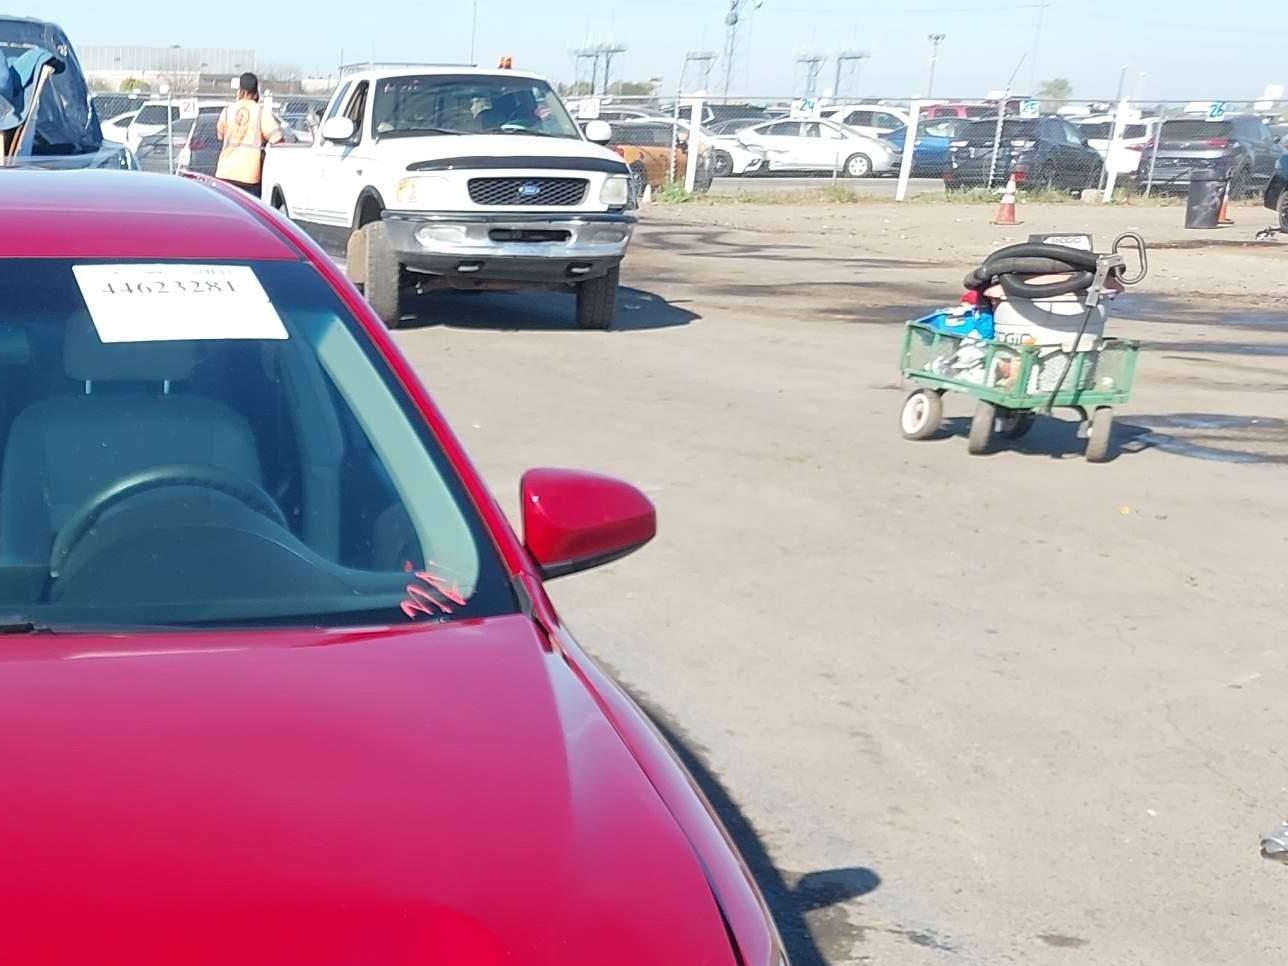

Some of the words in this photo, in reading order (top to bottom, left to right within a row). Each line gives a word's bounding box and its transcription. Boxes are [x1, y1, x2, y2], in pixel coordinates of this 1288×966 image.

[182, 101, 196, 113] 21
[800, 98, 815, 112] 24
[1023, 100, 1037, 115] 25
[1209, 102, 1226, 118] 26
[101, 279, 236, 295] 44623281
